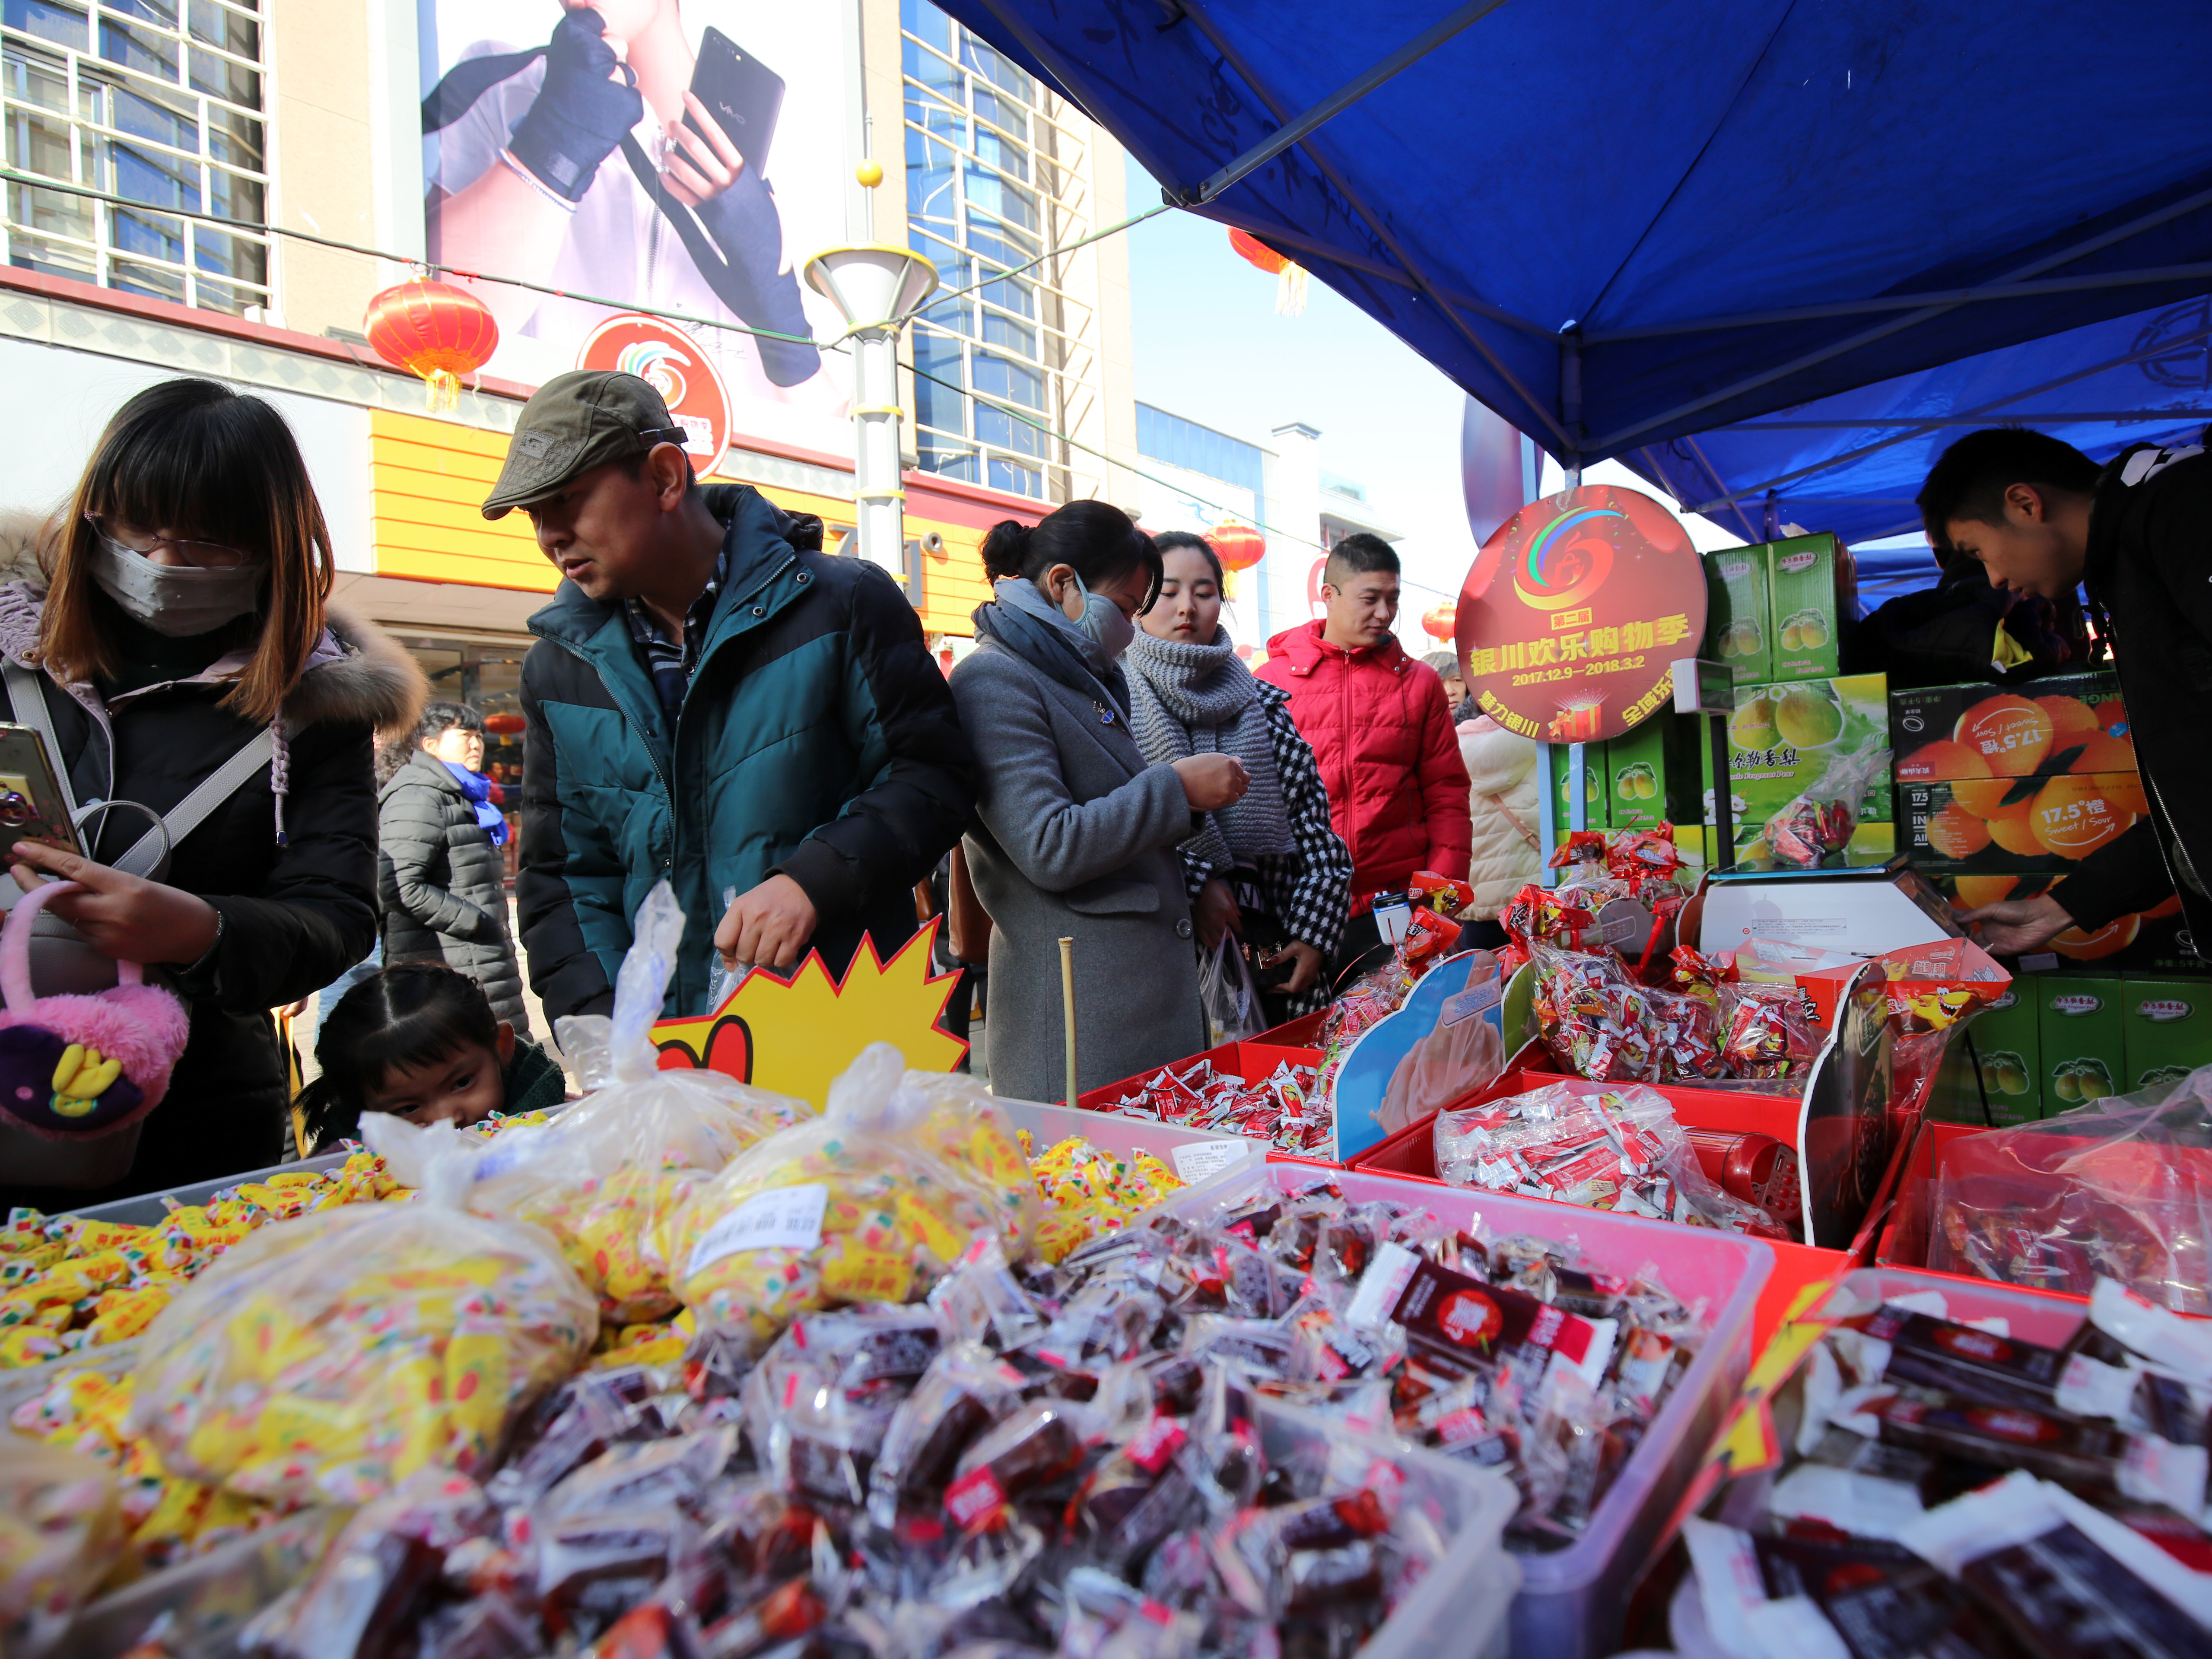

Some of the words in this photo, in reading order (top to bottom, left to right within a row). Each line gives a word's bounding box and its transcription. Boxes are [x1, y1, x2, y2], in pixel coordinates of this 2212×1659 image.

[719, 101, 745, 124] vivo
[1553, 610, 1590, 627] 第二届
[1471, 613, 1689, 676] 银川欢乐购物季
[2079, 693, 2122, 704] ANGE
[1478, 690, 1541, 738] 魅力银川
[2006, 717, 2039, 731] Sweet
[1975, 728, 1996, 737] Sour
[1745, 772, 1776, 780] Fragrant
[1912, 793, 1928, 802] 17.5
[1913, 816, 1927, 824] IN
[2045, 822, 2079, 836] Sweet
[2089, 817, 2112, 826] Sour
[1455, 985, 1495, 1018] 牛奶味夹心
